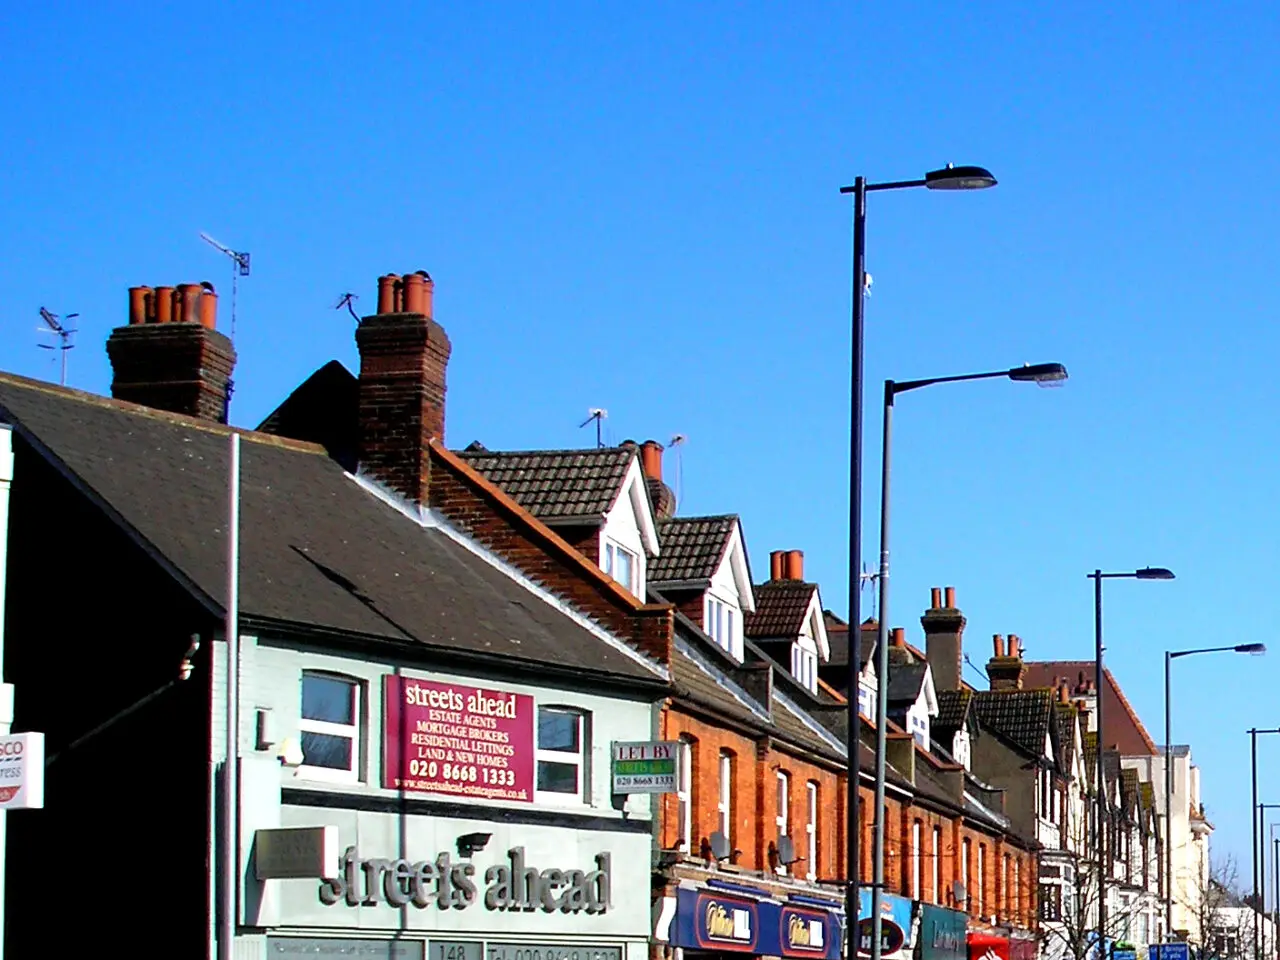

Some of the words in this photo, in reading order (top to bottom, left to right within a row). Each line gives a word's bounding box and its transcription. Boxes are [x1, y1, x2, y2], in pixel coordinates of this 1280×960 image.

[405, 684, 464, 711] streets
[467, 690, 517, 718] ahead
[429, 709, 462, 724] ESTATE
[463, 714, 497, 729] AGENTS
[416, 720, 468, 738] MORTGAGE
[468, 728, 509, 743] BROKERS
[411, 732, 470, 751] RESIDENTIAL
[471, 740, 515, 757] LETTINGS
[618, 746, 645, 759] LET
[653, 745, 672, 758] BY
[418, 747, 446, 760] LAND
[446, 749, 454, 761] &
[455, 750, 476, 763] NEW
[476, 753, 508, 768] HOMES
[410, 760, 437, 778] 020
[442, 763, 477, 782] 8668
[481, 768, 515, 787] 1333
[319, 846, 476, 910] streets
[484, 846, 614, 916] ahead
